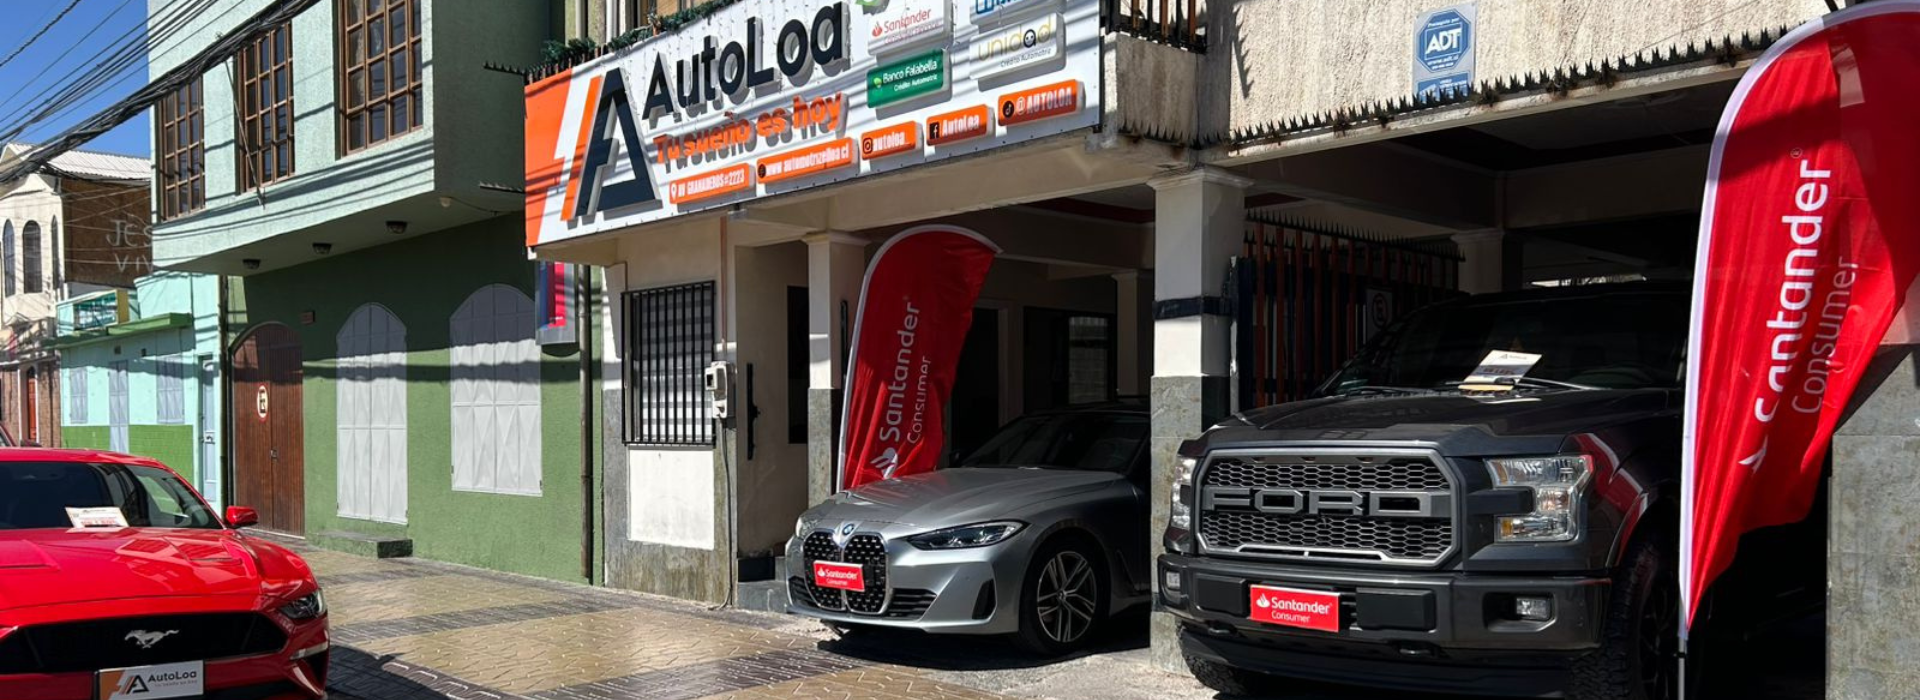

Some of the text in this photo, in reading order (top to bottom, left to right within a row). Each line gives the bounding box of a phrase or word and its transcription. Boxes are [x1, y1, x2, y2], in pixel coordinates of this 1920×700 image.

[884, 9, 931, 33] Santander
[1425, 28, 1462, 55] ADT
[642, 2, 842, 120] AutoLoa
[882, 60, 937, 84] Banco Falabella
[653, 91, 842, 164] Tu sueño es hoy
[941, 114, 980, 137] AutoLoa
[1791, 256, 1859, 414] Consumer
[879, 302, 920, 442] Santander
[907, 355, 931, 444] Consumer
[1202, 486, 1432, 517] FORD
[825, 568, 857, 580] Santander
[1271, 596, 1330, 615] Santander
[1271, 610, 1311, 623] Consumer
[147, 670, 197, 683] AutoLoa
